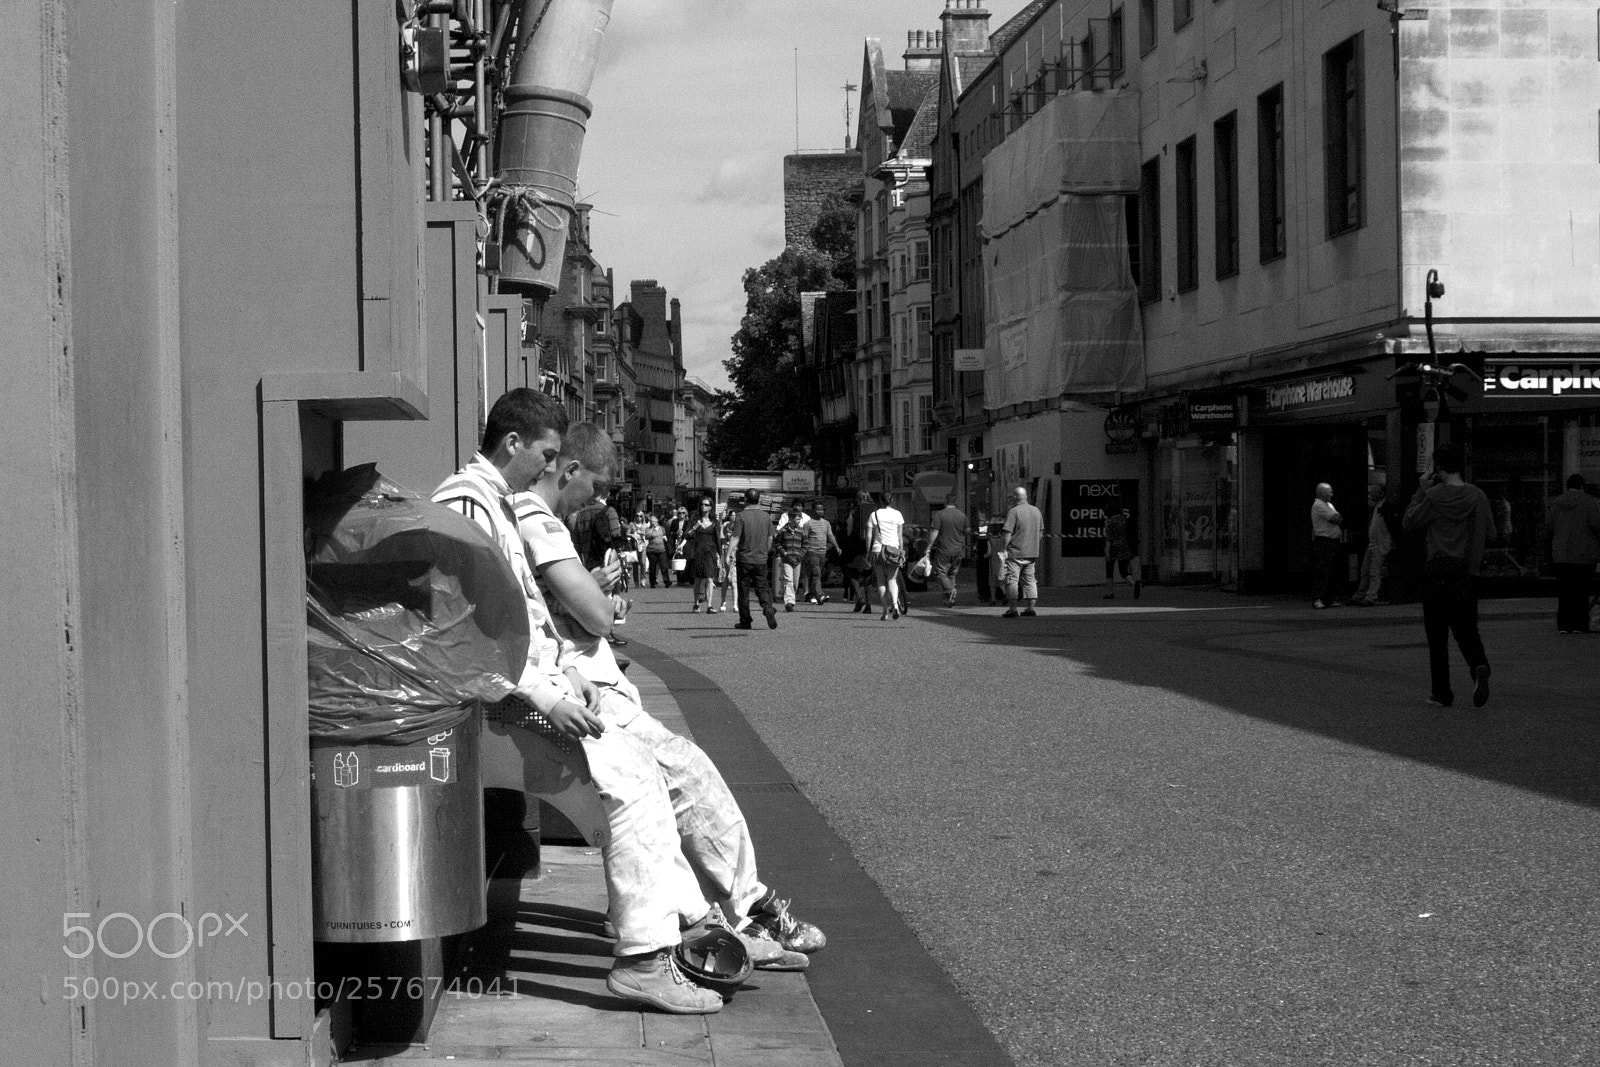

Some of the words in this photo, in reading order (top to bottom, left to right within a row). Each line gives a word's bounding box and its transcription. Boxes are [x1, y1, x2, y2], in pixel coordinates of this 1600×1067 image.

[1484, 364, 1496, 392] THE
[1269, 384, 1306, 411] Carphone
[1306, 376, 1354, 402] Warehouse
[1194, 403, 1234, 413] Carphone
[1191, 412, 1234, 420] Warehouse
[1079, 483, 1120, 497] next
[376, 761, 426, 773] cardboard
[325, 921, 382, 930] FURNITUBES
